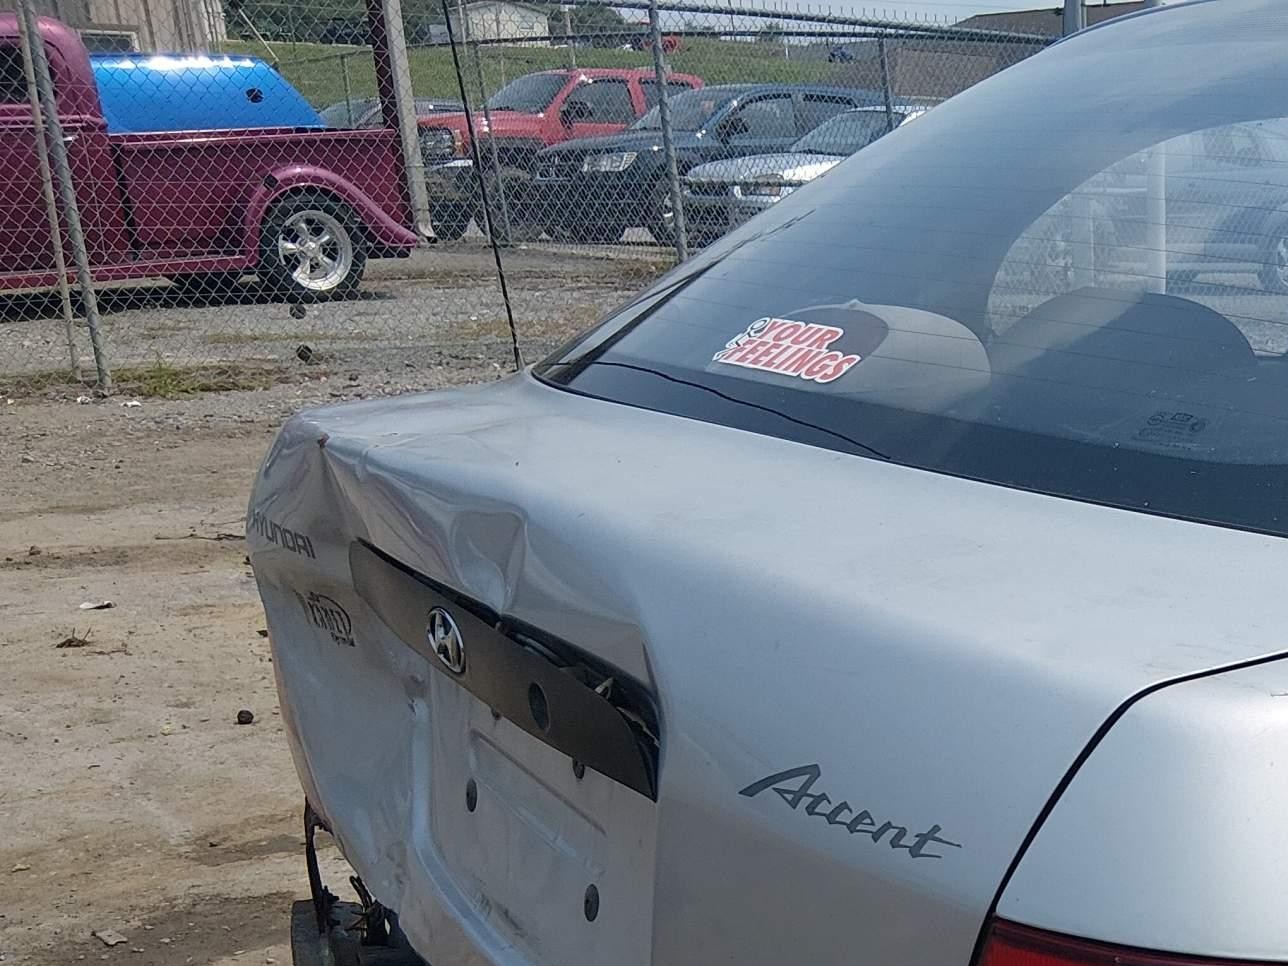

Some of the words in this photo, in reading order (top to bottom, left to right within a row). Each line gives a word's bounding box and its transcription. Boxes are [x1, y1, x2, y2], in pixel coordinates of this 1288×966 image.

[758, 320, 840, 348] YOUR
[725, 339, 858, 381] FEELINGS
[738, 763, 962, 859] Accent
